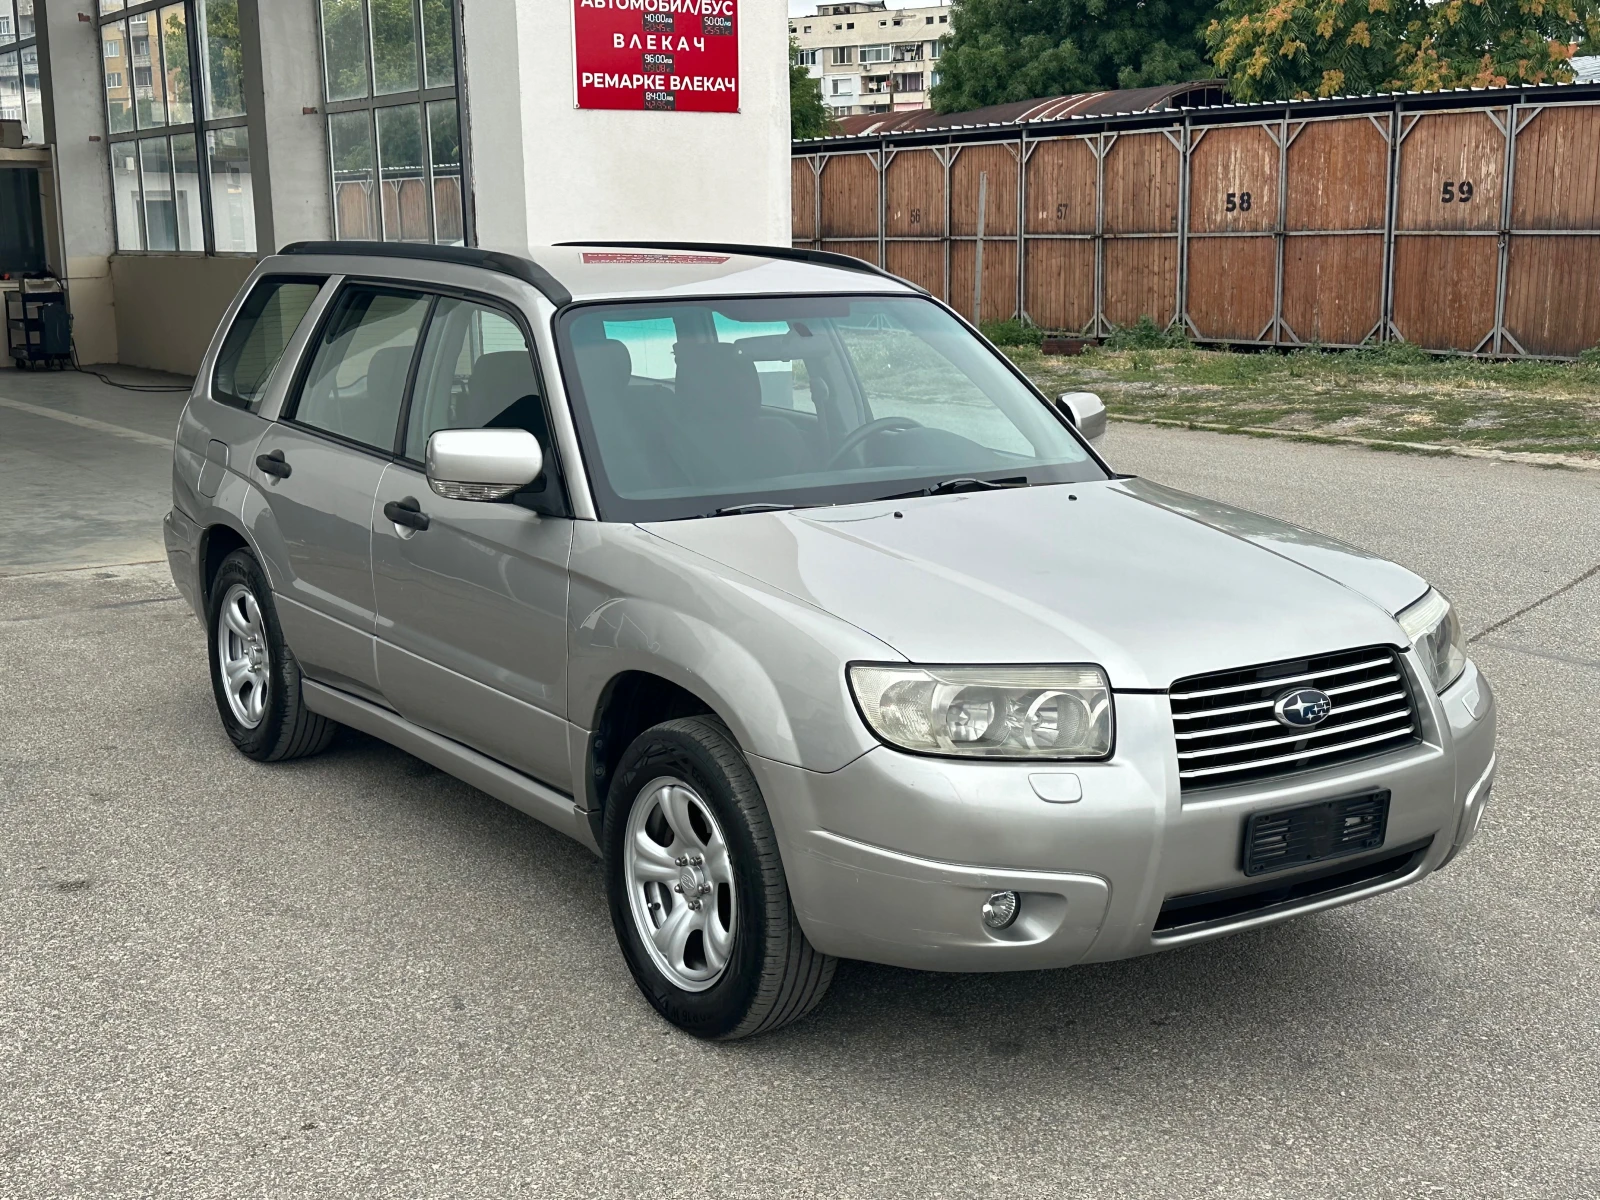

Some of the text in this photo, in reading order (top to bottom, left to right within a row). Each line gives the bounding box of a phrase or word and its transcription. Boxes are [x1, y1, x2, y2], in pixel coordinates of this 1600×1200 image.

[613, 33, 705, 52] ВЛЕКАЧ
[582, 72, 736, 92] РЕМАРКЕ ВЛЕКАЧ
[1225, 191, 1252, 212] 58
[1441, 181, 1474, 203] 59
[910, 208, 921, 224] 56
[1056, 203, 1069, 220] 57
